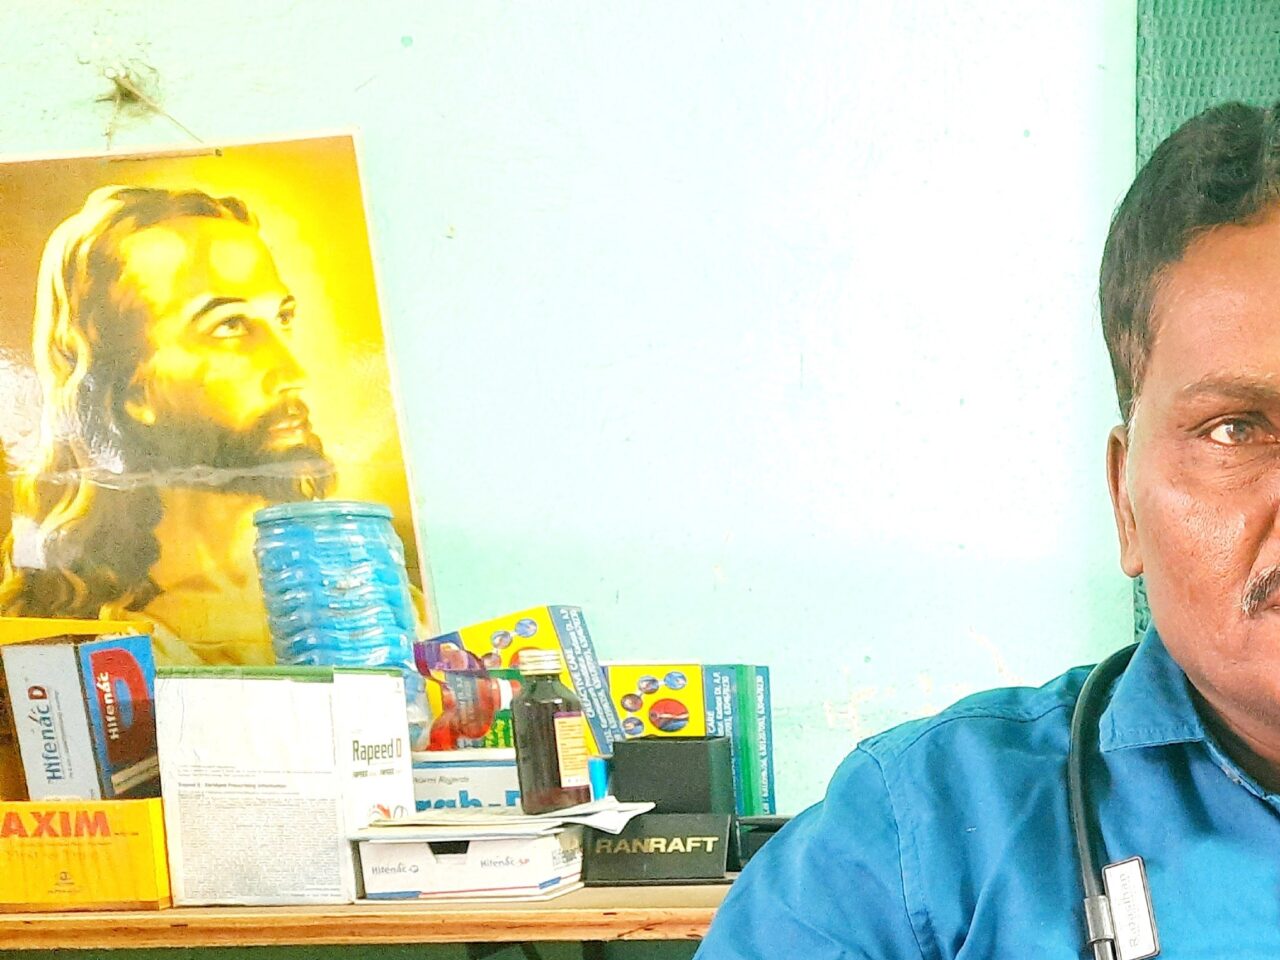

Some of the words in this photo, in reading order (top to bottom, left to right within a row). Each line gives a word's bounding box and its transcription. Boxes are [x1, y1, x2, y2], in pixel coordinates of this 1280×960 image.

[28, 685, 48, 700] D
[352, 738, 393, 765] Rapeed
[0, 811, 111, 837] AXIM
[595, 836, 719, 854] RANRAFT
